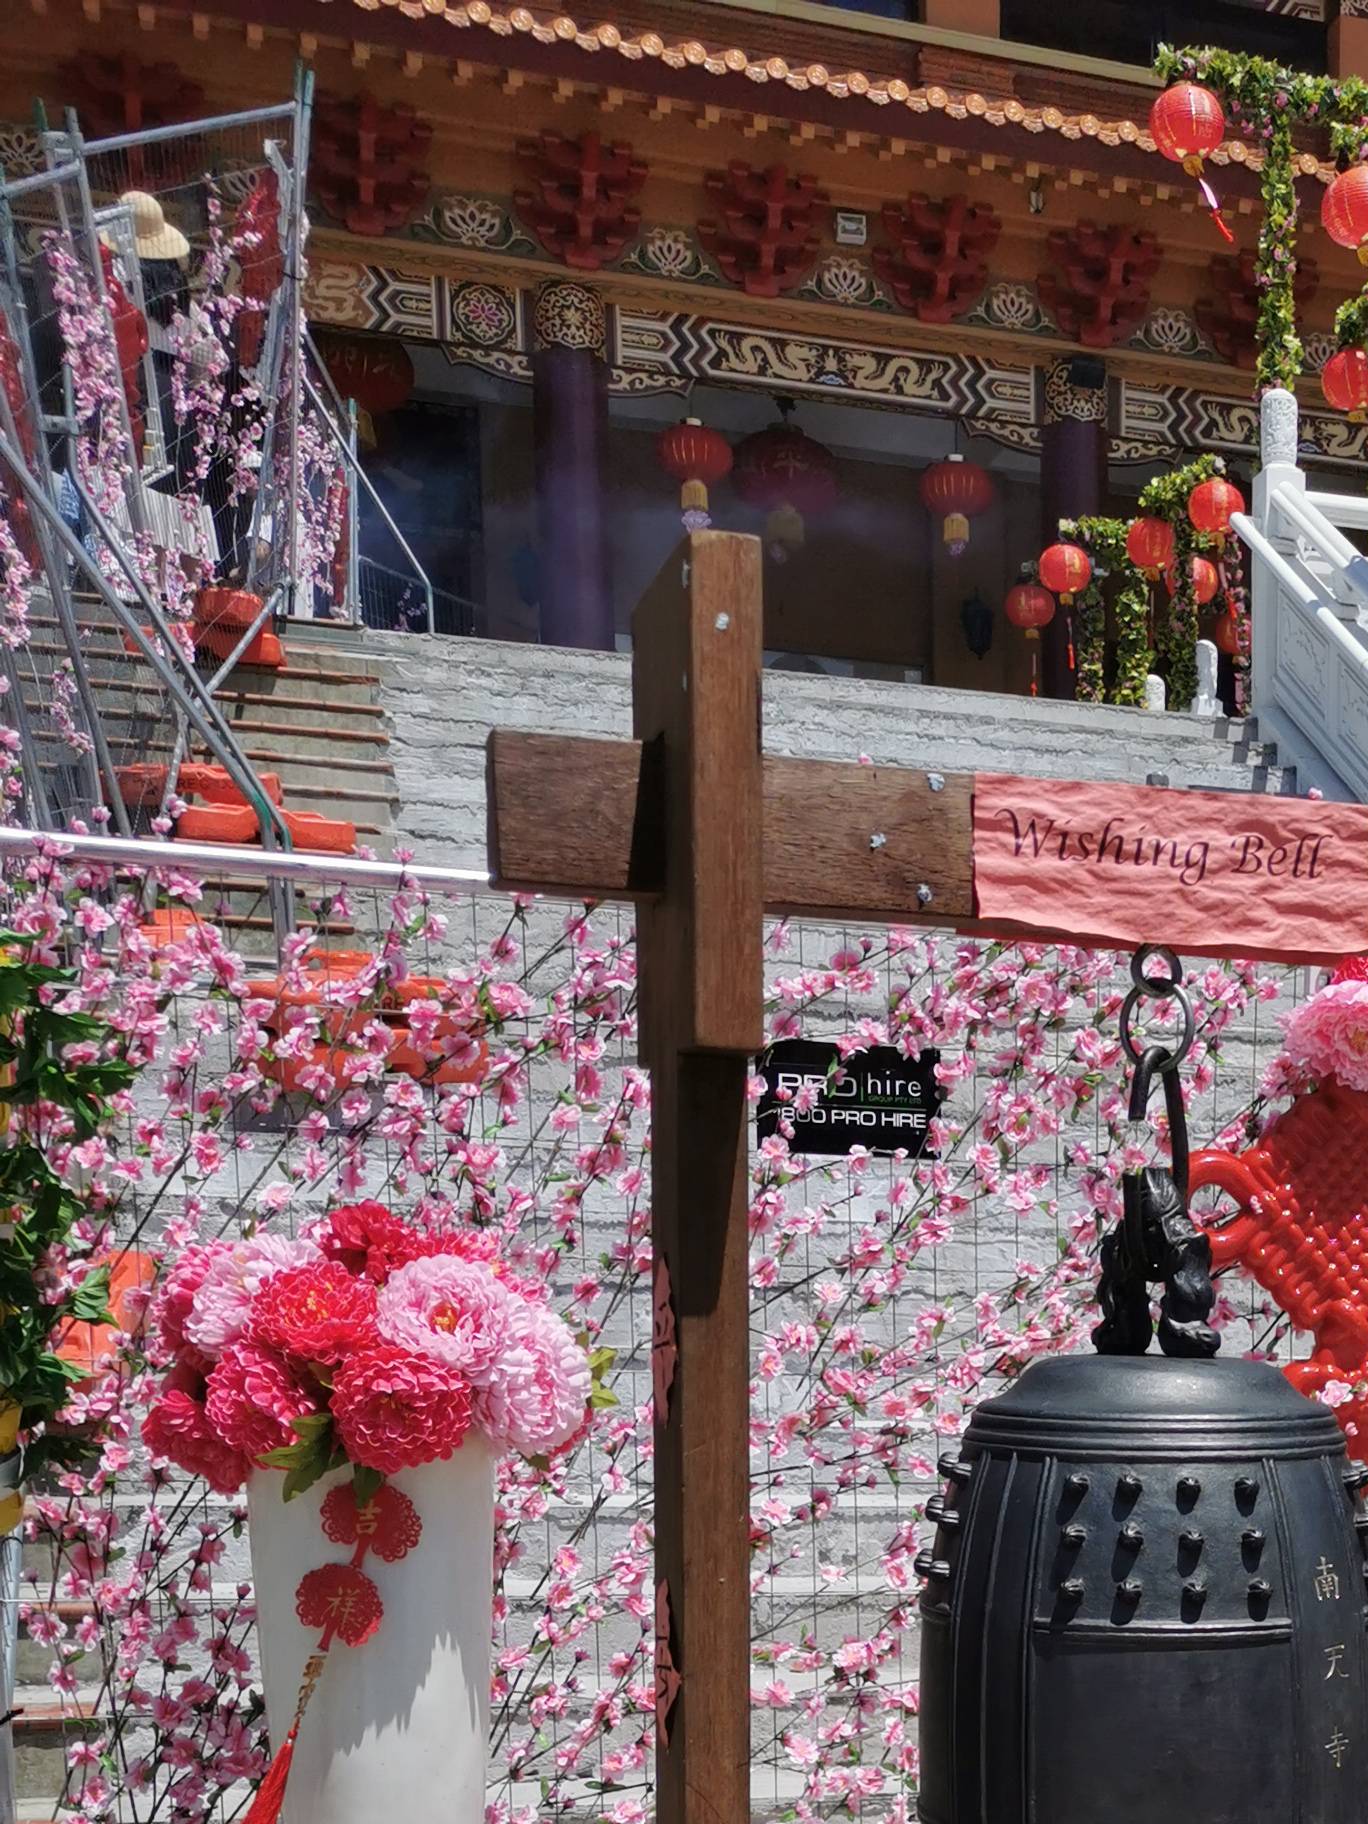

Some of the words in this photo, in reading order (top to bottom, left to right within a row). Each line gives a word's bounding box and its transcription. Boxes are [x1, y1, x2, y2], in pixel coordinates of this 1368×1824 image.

[994, 808, 1210, 886] Wishing
[1230, 834, 1334, 880] Bell
[867, 1071, 922, 1097] hire
[831, 1110, 876, 1126] PRO
[881, 1113, 927, 1129] HIRE
[1312, 1556, 1350, 1768] 南天寺
